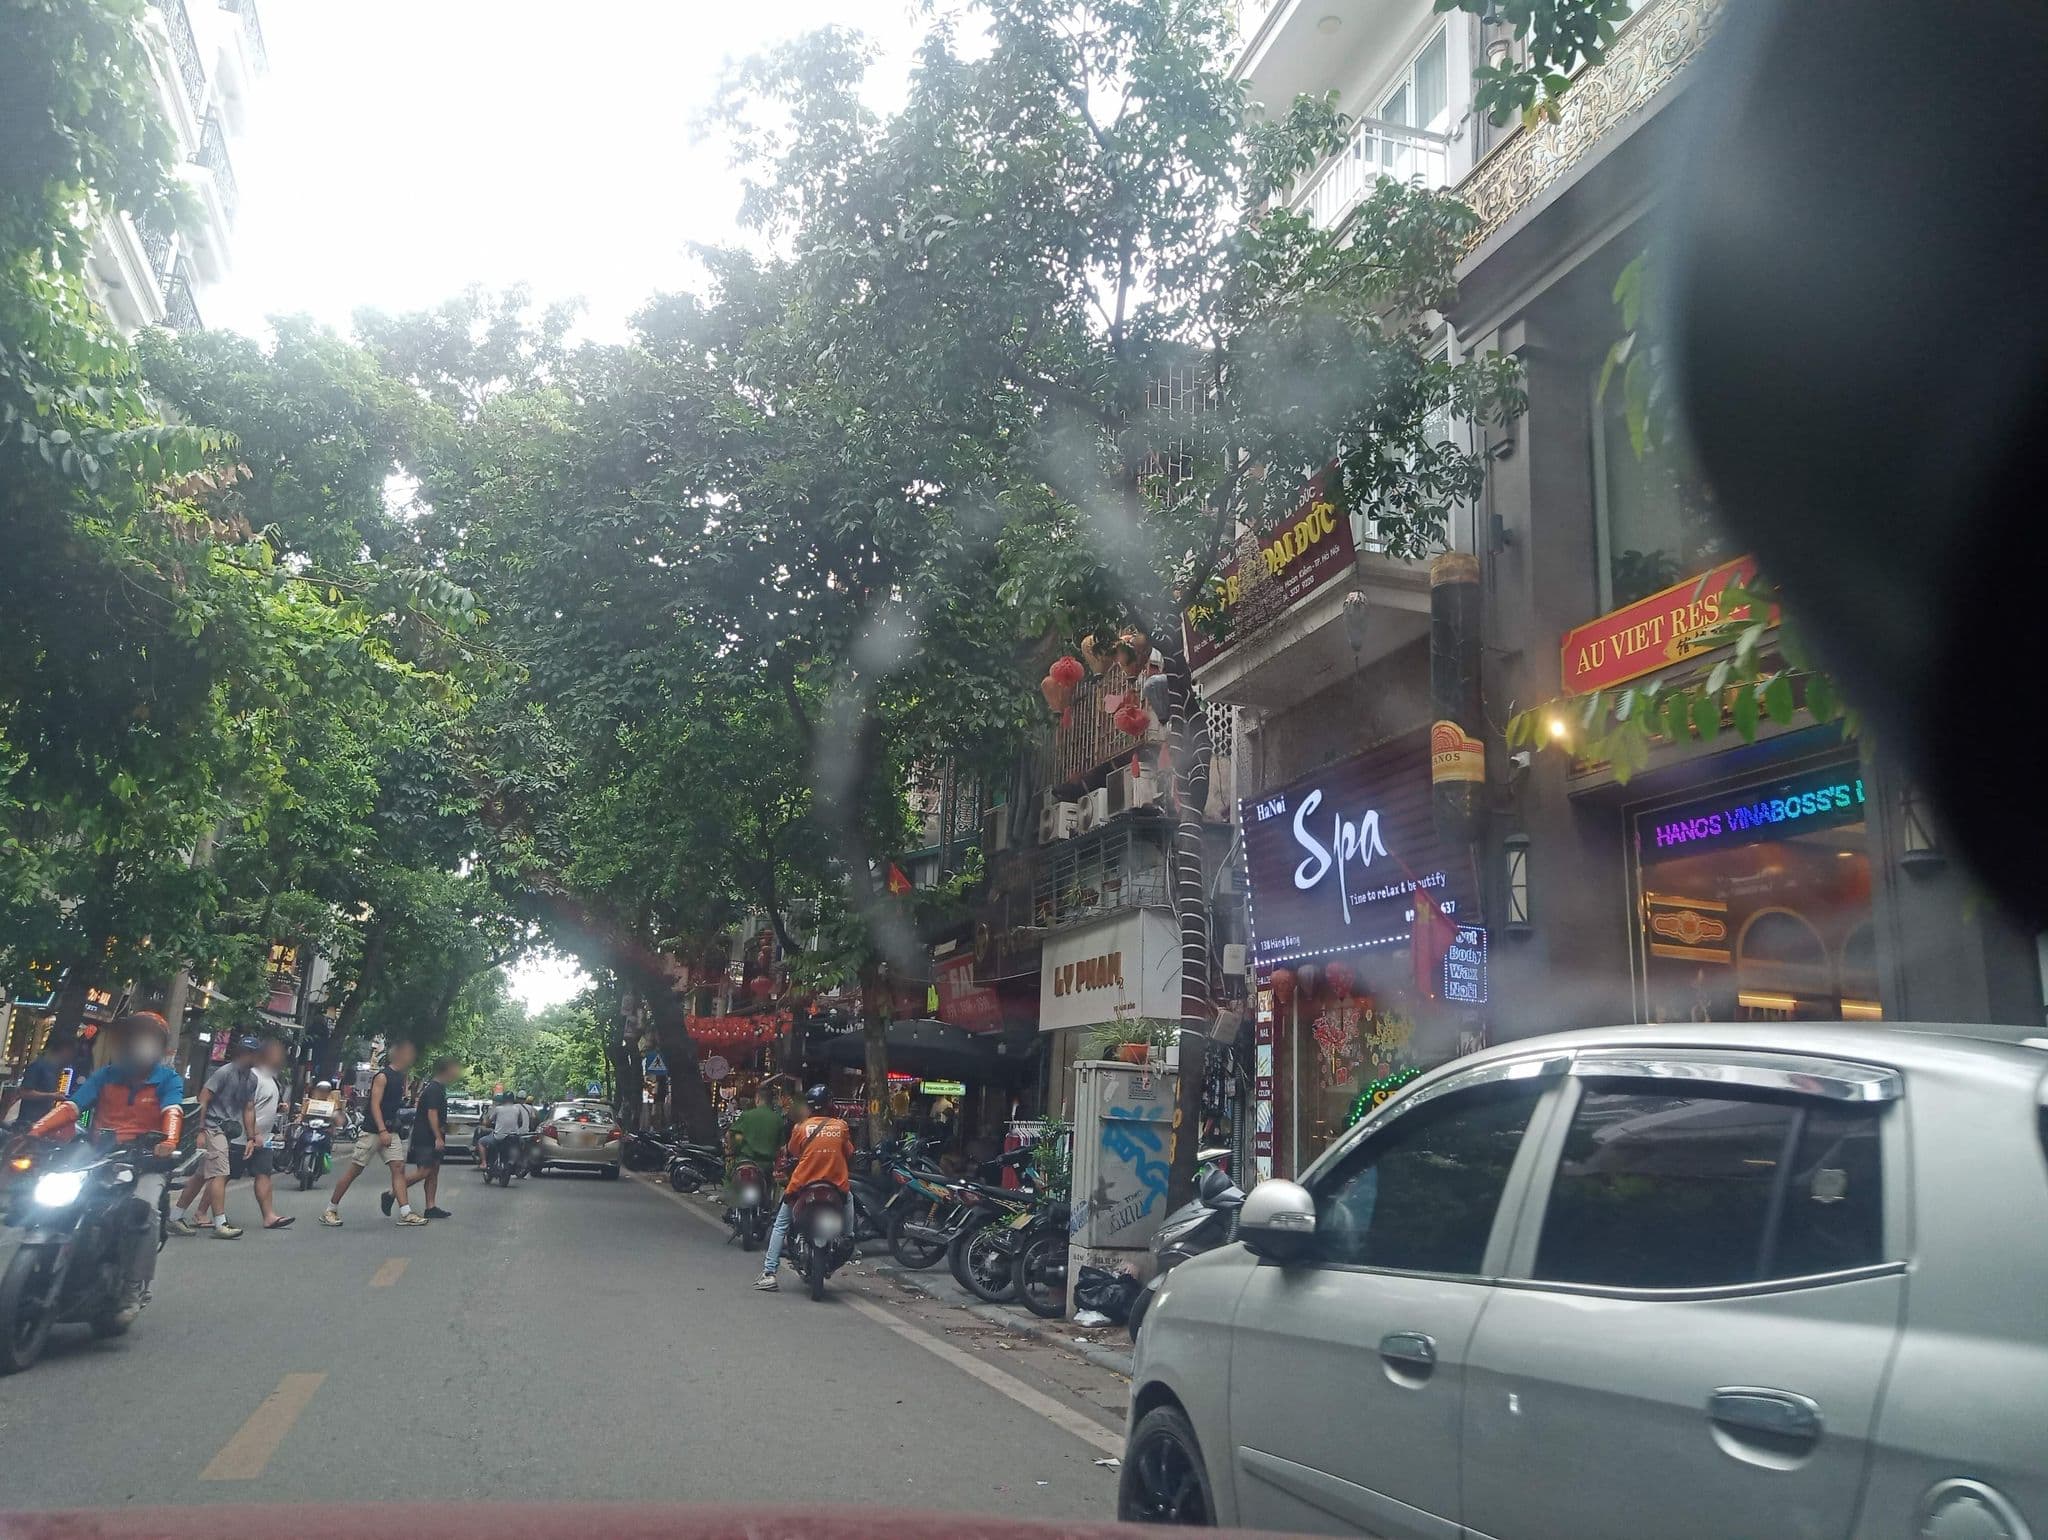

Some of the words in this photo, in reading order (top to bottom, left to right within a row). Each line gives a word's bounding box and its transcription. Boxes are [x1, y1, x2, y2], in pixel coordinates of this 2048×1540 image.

[1294, 502, 1336, 555] ĐỨC
[1575, 640, 1607, 675] AU
[1609, 614, 1665, 661] VIET
[1256, 795, 1286, 821] HaNoi
[1292, 788, 1388, 925] Spa
[1349, 892, 1367, 907] Time
[1366, 888, 1376, 902] to
[1376, 883, 1401, 900] relax
[1449, 945, 1482, 965] Body
[1054, 964, 1075, 998] LY
[1449, 963, 1479, 981] Wax
